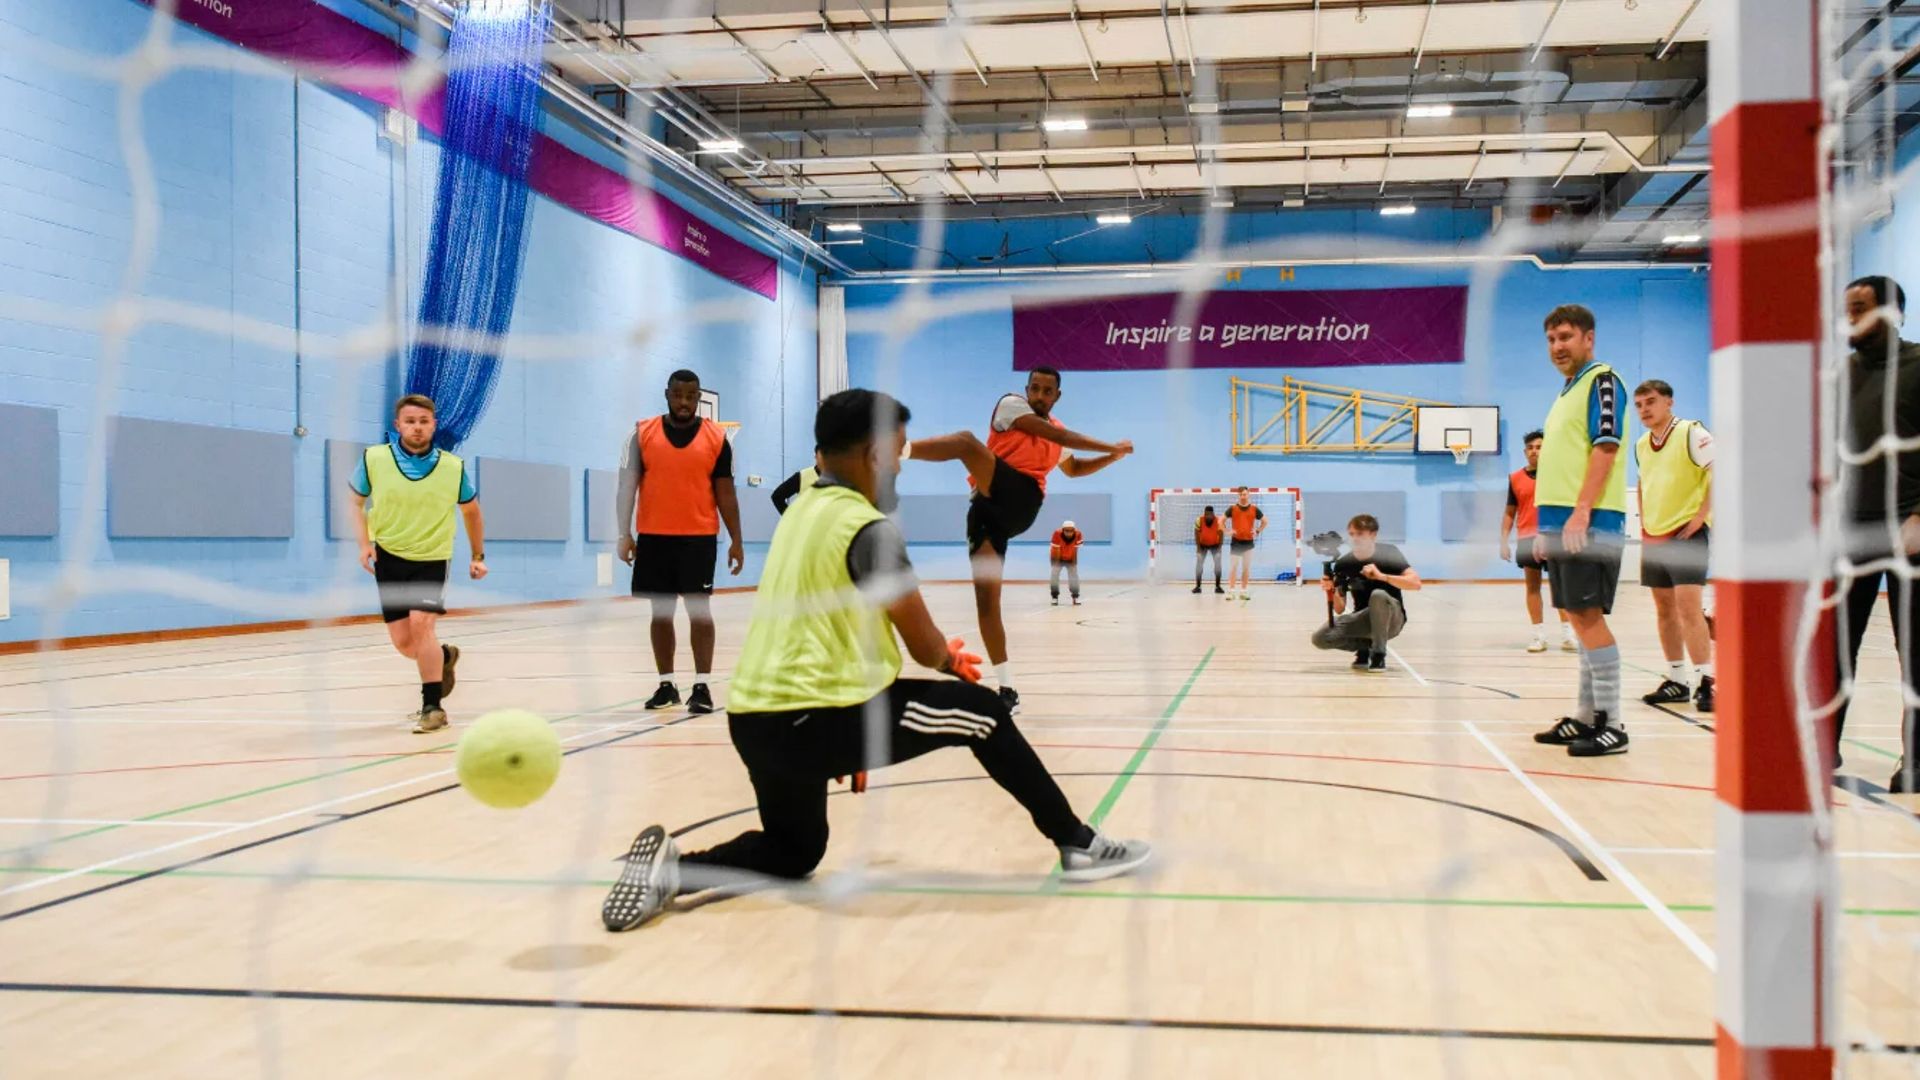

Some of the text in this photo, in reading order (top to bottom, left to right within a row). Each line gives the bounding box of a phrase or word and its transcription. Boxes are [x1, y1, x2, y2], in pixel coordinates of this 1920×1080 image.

[1105, 316, 1370, 350] Inspire a generation
